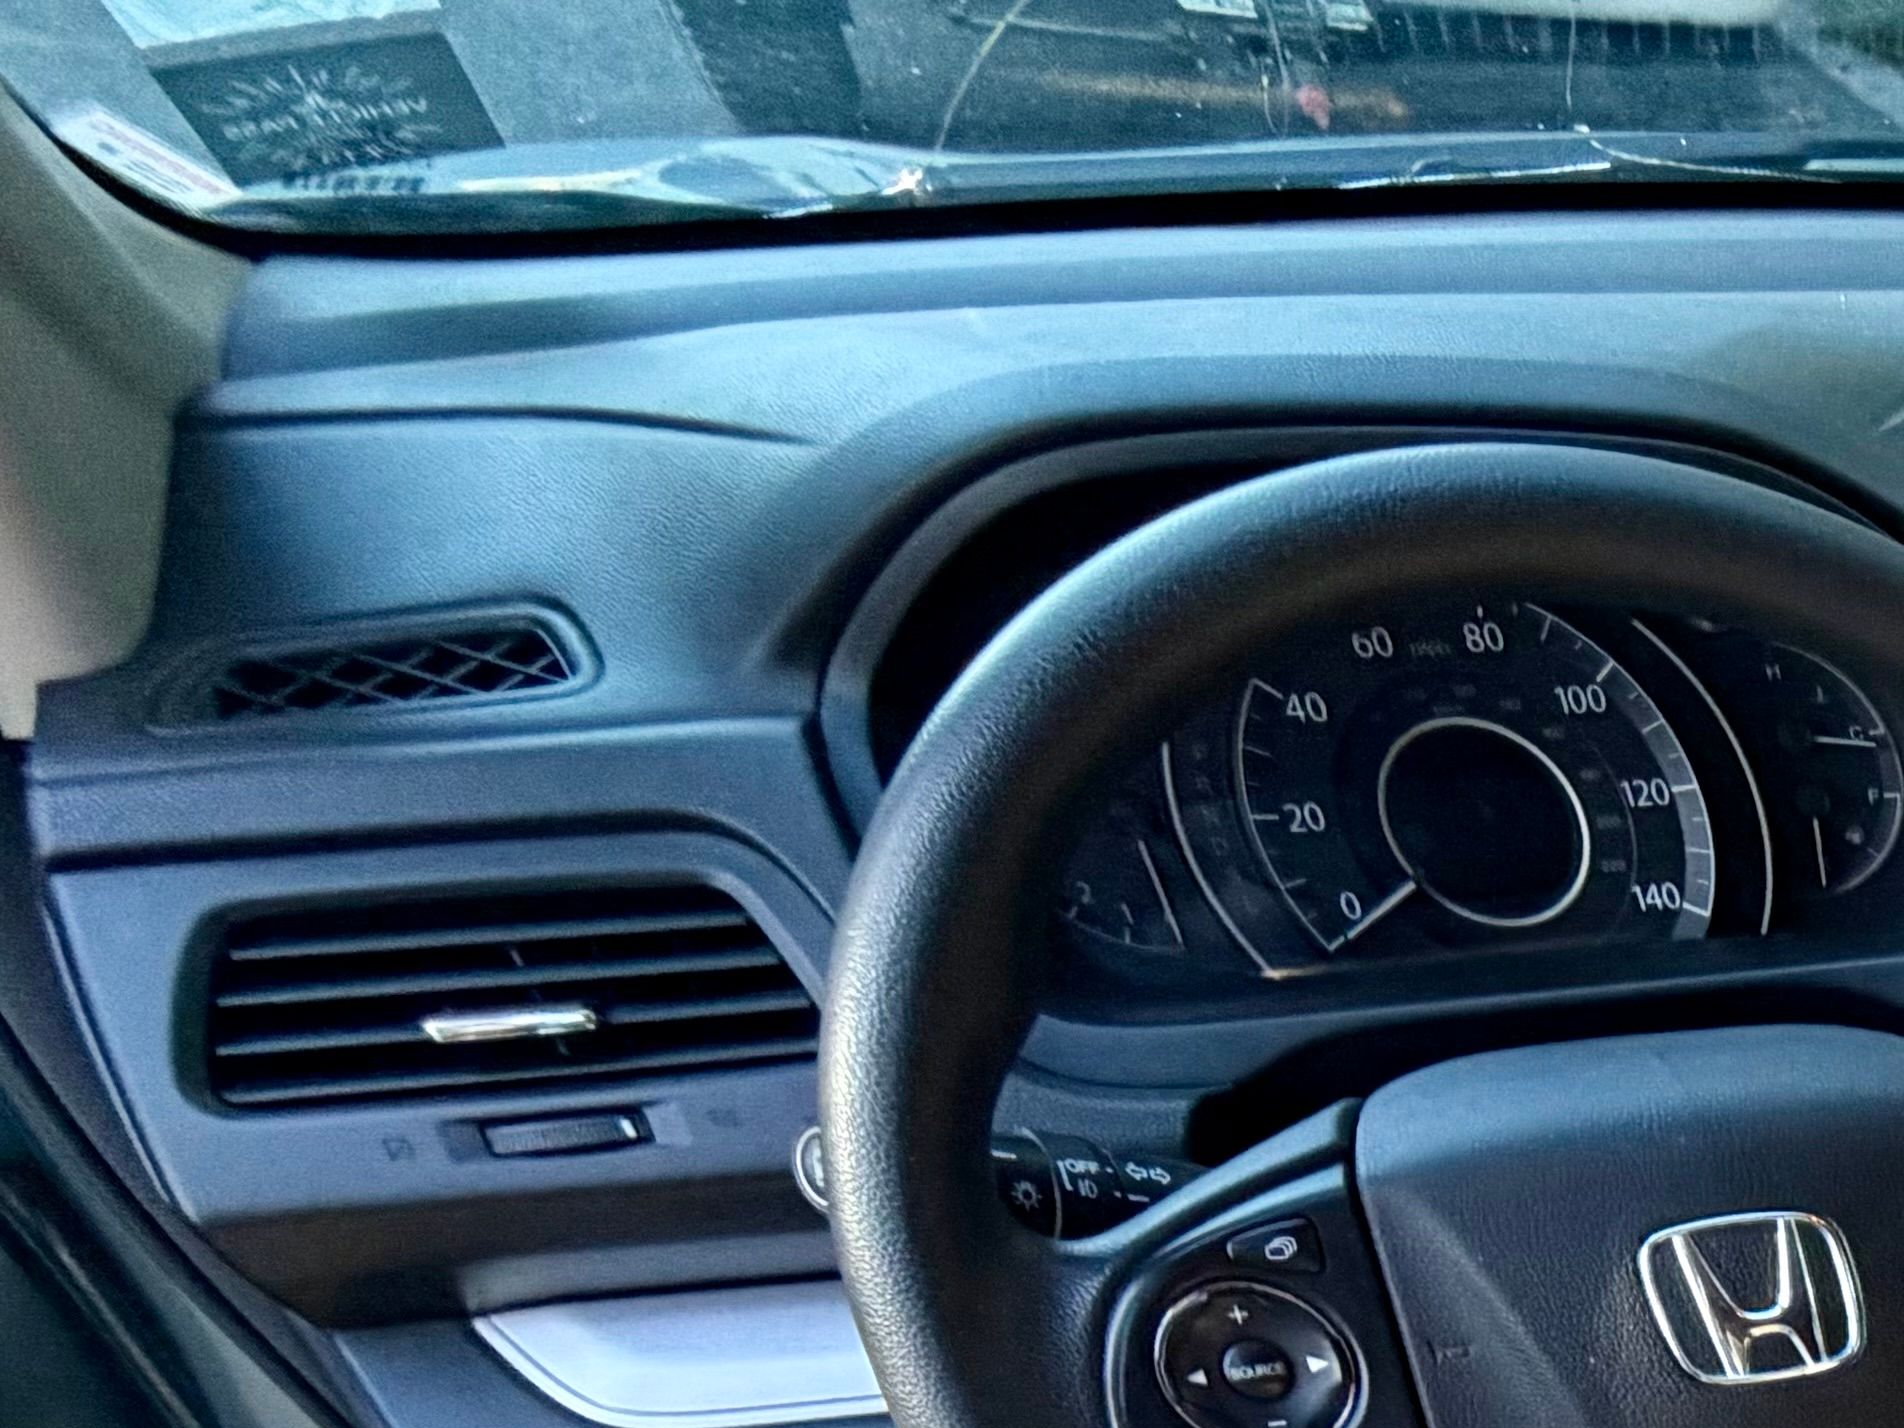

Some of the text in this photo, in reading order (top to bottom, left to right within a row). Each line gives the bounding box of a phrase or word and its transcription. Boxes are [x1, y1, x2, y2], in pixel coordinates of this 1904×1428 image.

[1352, 626, 1393, 658] 60
[1463, 622, 1504, 652] 80
[1285, 691, 1328, 723] 40
[1554, 684, 1608, 716] 100
[1620, 777, 1671, 808] 120
[1282, 801, 1326, 833] 20
[1340, 891, 1362, 919] 0
[1631, 882, 1681, 912] 140
